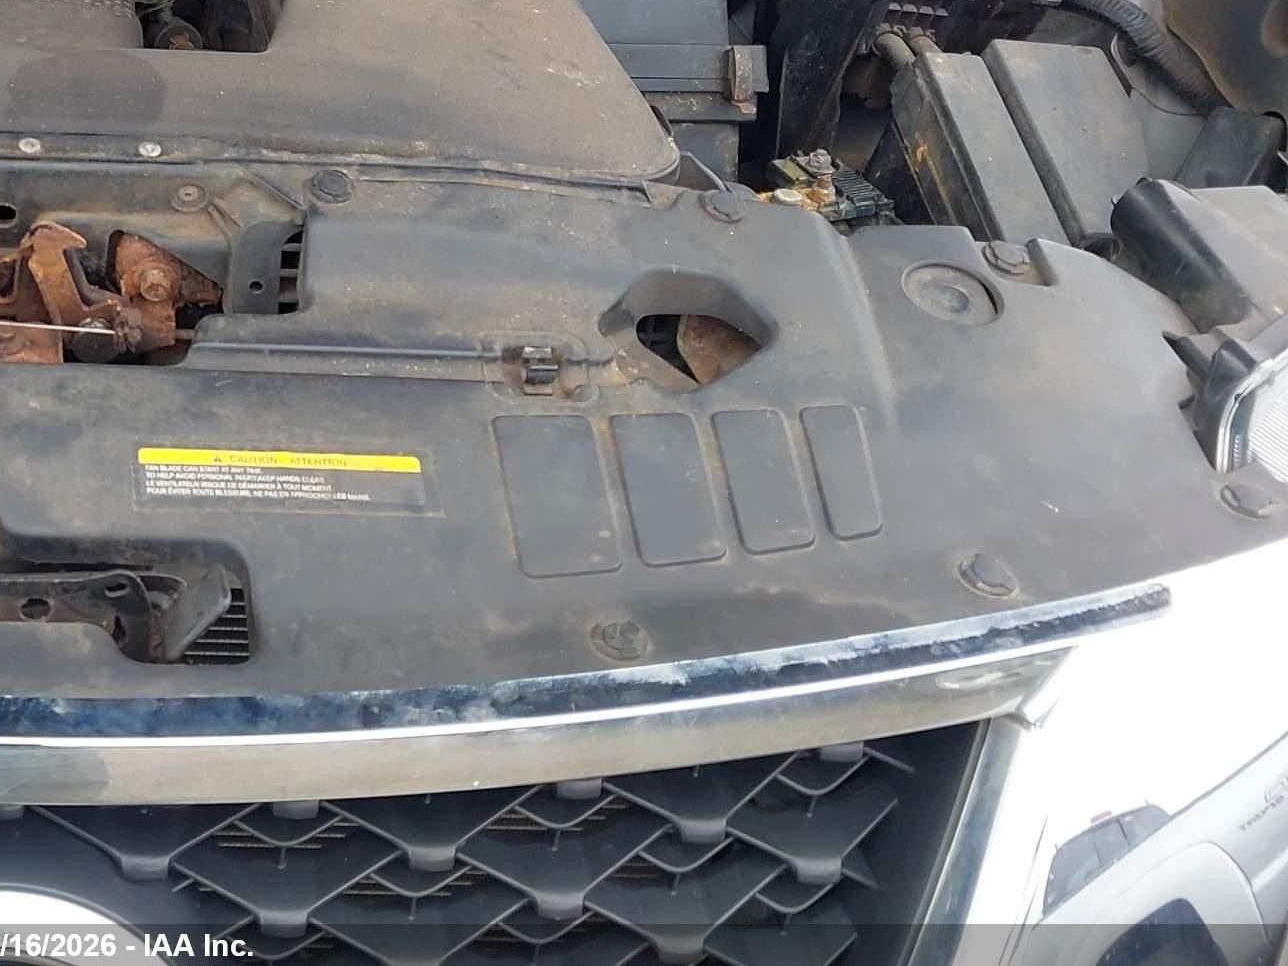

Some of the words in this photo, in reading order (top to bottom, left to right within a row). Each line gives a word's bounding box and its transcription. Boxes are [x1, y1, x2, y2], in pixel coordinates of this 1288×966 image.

[230, 454, 279, 465] CAUTION
[289, 456, 348, 468] ATTENTION
[160, 464, 182, 472] BLADE
[199, 465, 221, 473] START
[175, 472, 197, 480] AVOID
[197, 473, 232, 481] PERSONAL
[277, 475, 301, 483] HANDS
[284, 483, 301, 491] TOUT
[146, 487, 167, 495] POUR
[192, 488, 215, 496] TOUTE
[333, 492, 346, 500] LES
